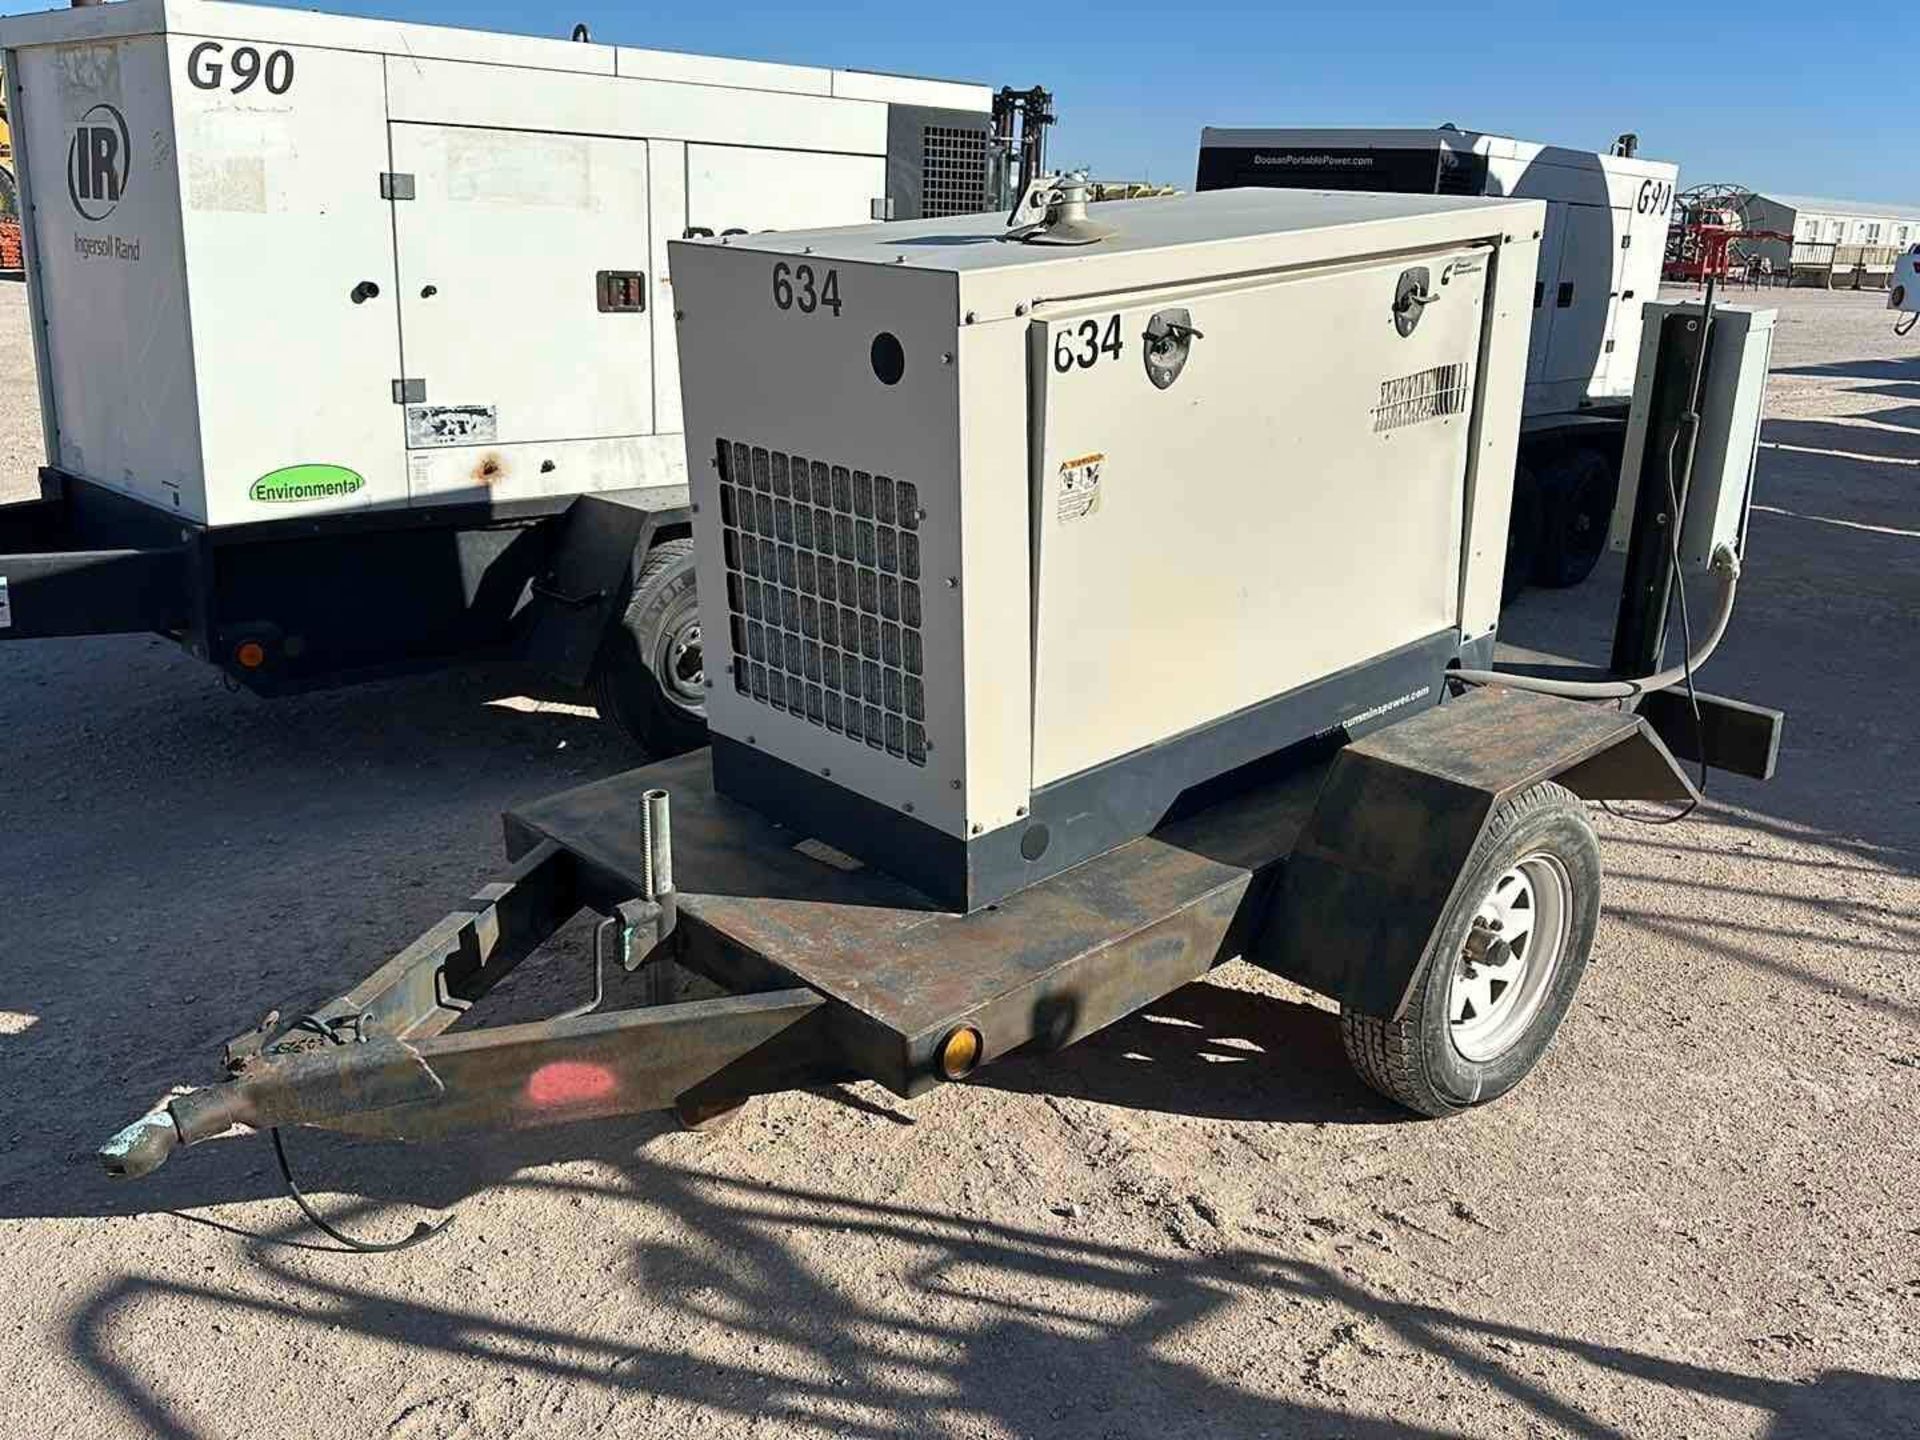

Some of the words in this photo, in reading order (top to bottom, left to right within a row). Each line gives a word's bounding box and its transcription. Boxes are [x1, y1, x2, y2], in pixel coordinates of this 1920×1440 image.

[187, 41, 295, 96] G90
[76, 127, 120, 201] IR
[74, 232, 113, 259] Ingersoll
[114, 236, 140, 262] Rand
[772, 262, 843, 317] 634
[1054, 313, 1124, 374] 634
[255, 478, 361, 501] Environmental
